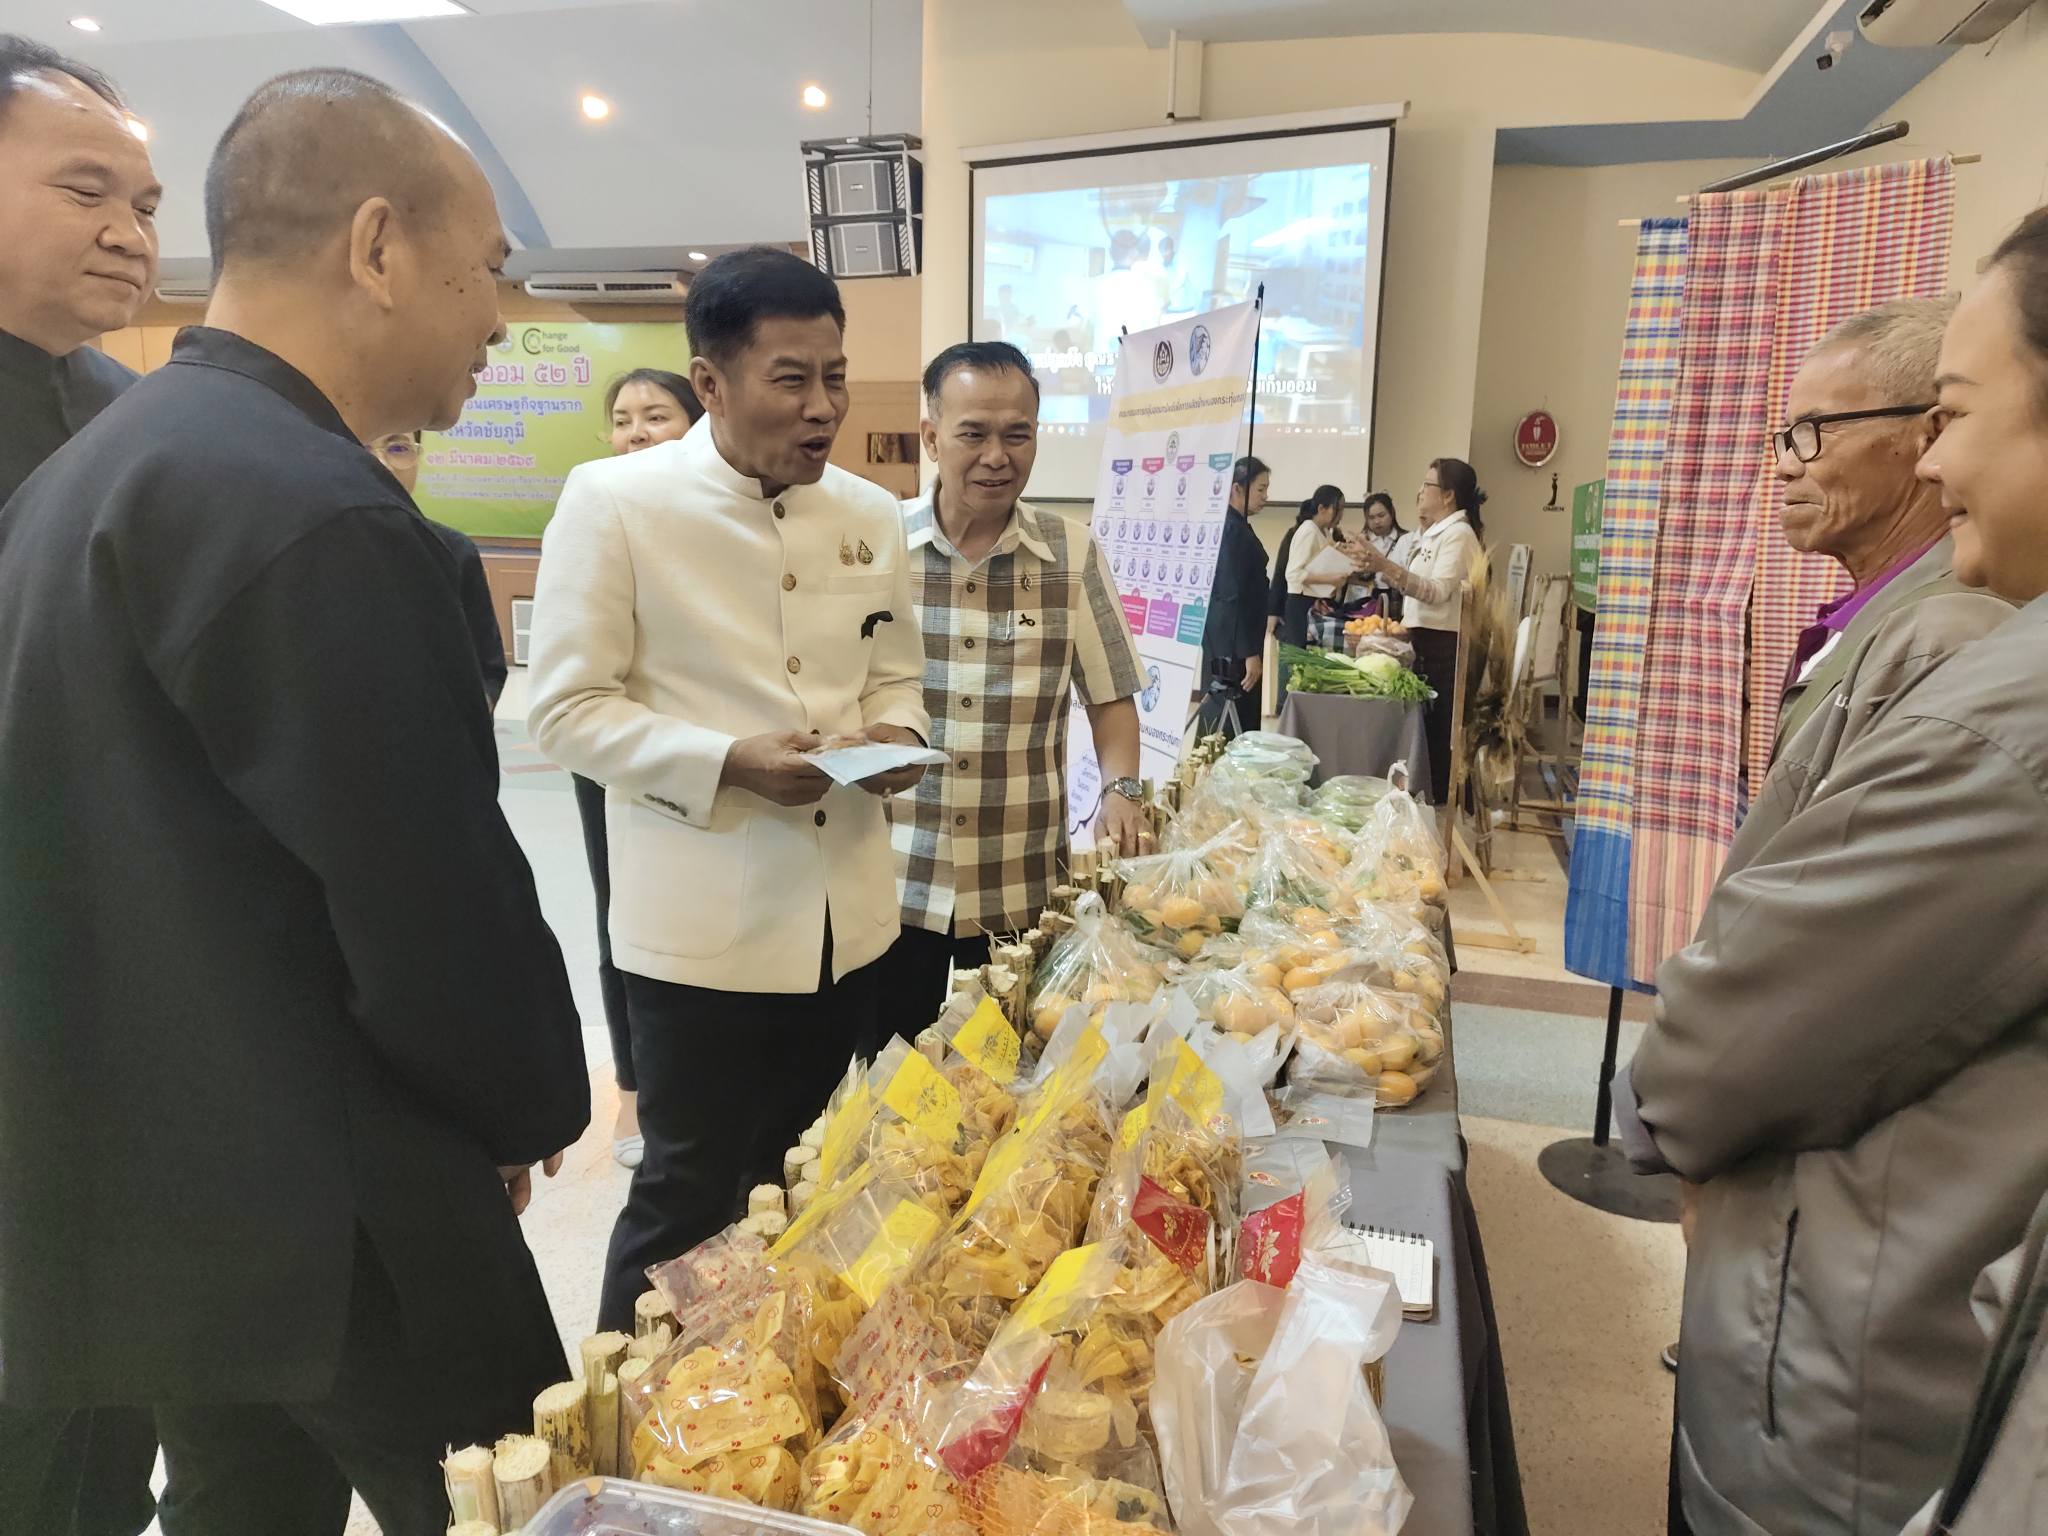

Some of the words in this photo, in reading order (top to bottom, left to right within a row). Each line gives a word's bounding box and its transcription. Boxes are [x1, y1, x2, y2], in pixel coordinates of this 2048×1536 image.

[557, 344, 580, 353] Good
[476, 366, 524, 382] ออม
[534, 363, 566, 383] ๕๒
[574, 356, 590, 384] ปี
[439, 421, 525, 445] หวัดชัยภูมิ
